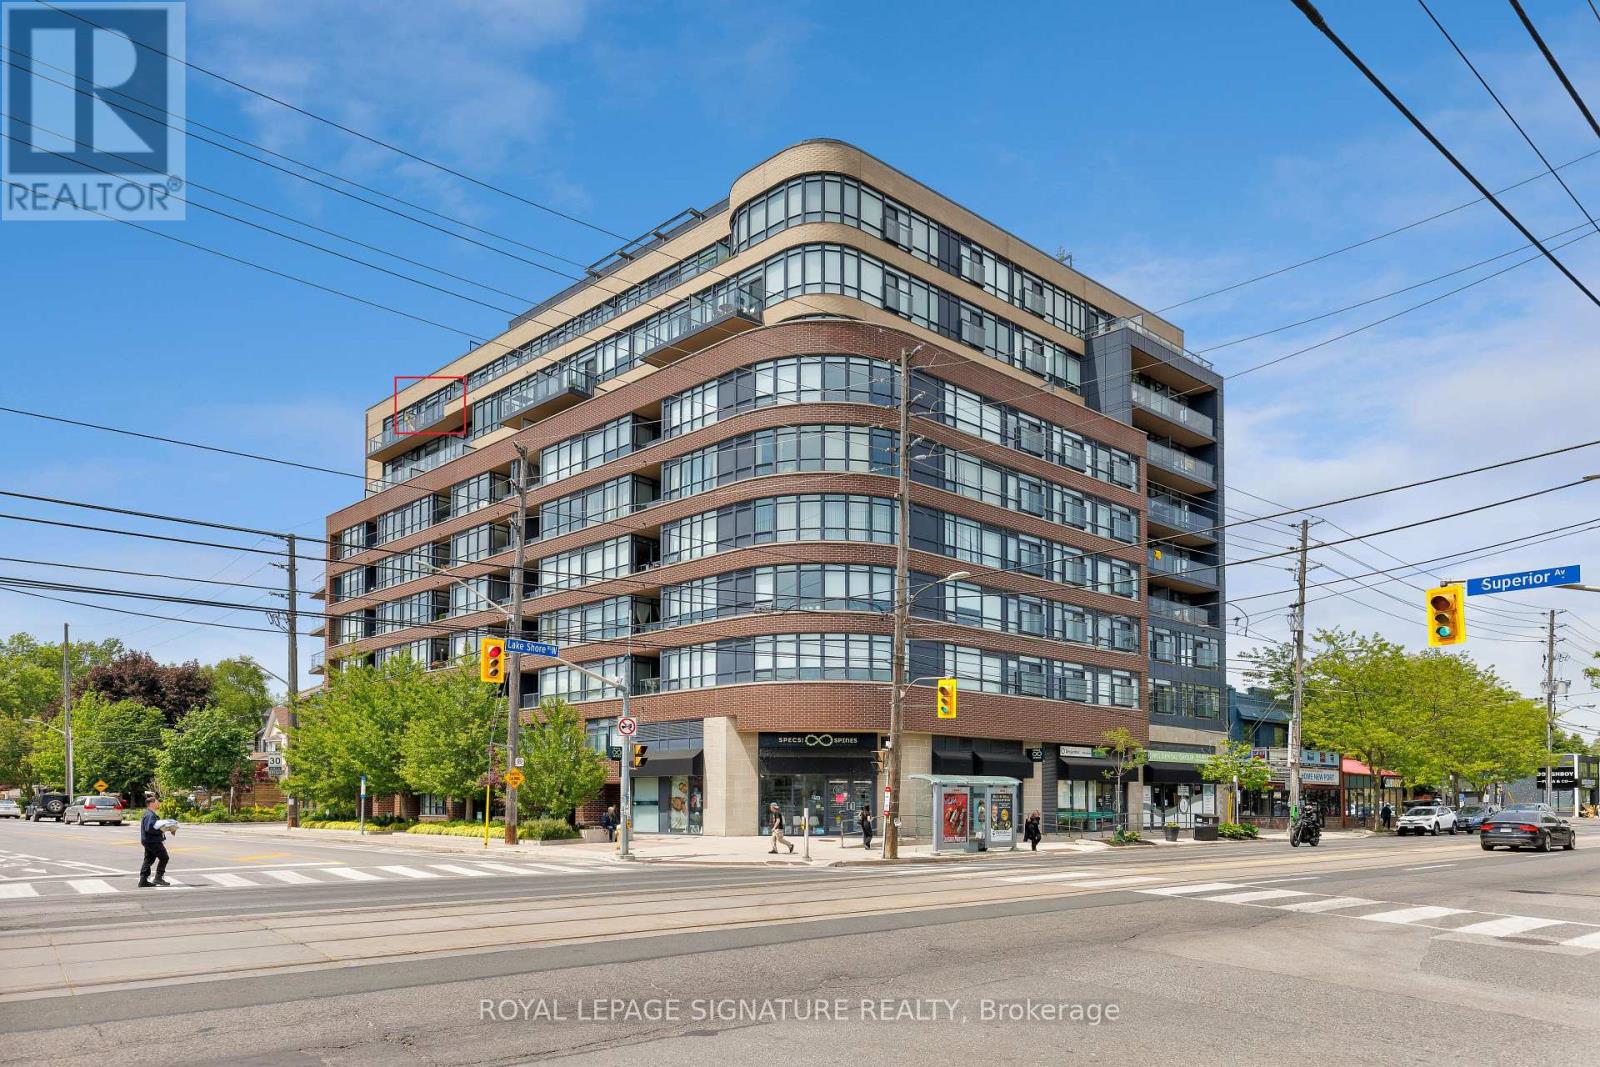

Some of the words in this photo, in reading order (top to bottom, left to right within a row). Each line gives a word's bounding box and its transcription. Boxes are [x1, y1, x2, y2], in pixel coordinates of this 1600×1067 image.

[1481, 572, 1550, 591] Superior
[508, 640, 525, 650] Lake
[526, 642, 546, 654] Shore
[270, 757, 281, 765] 30
